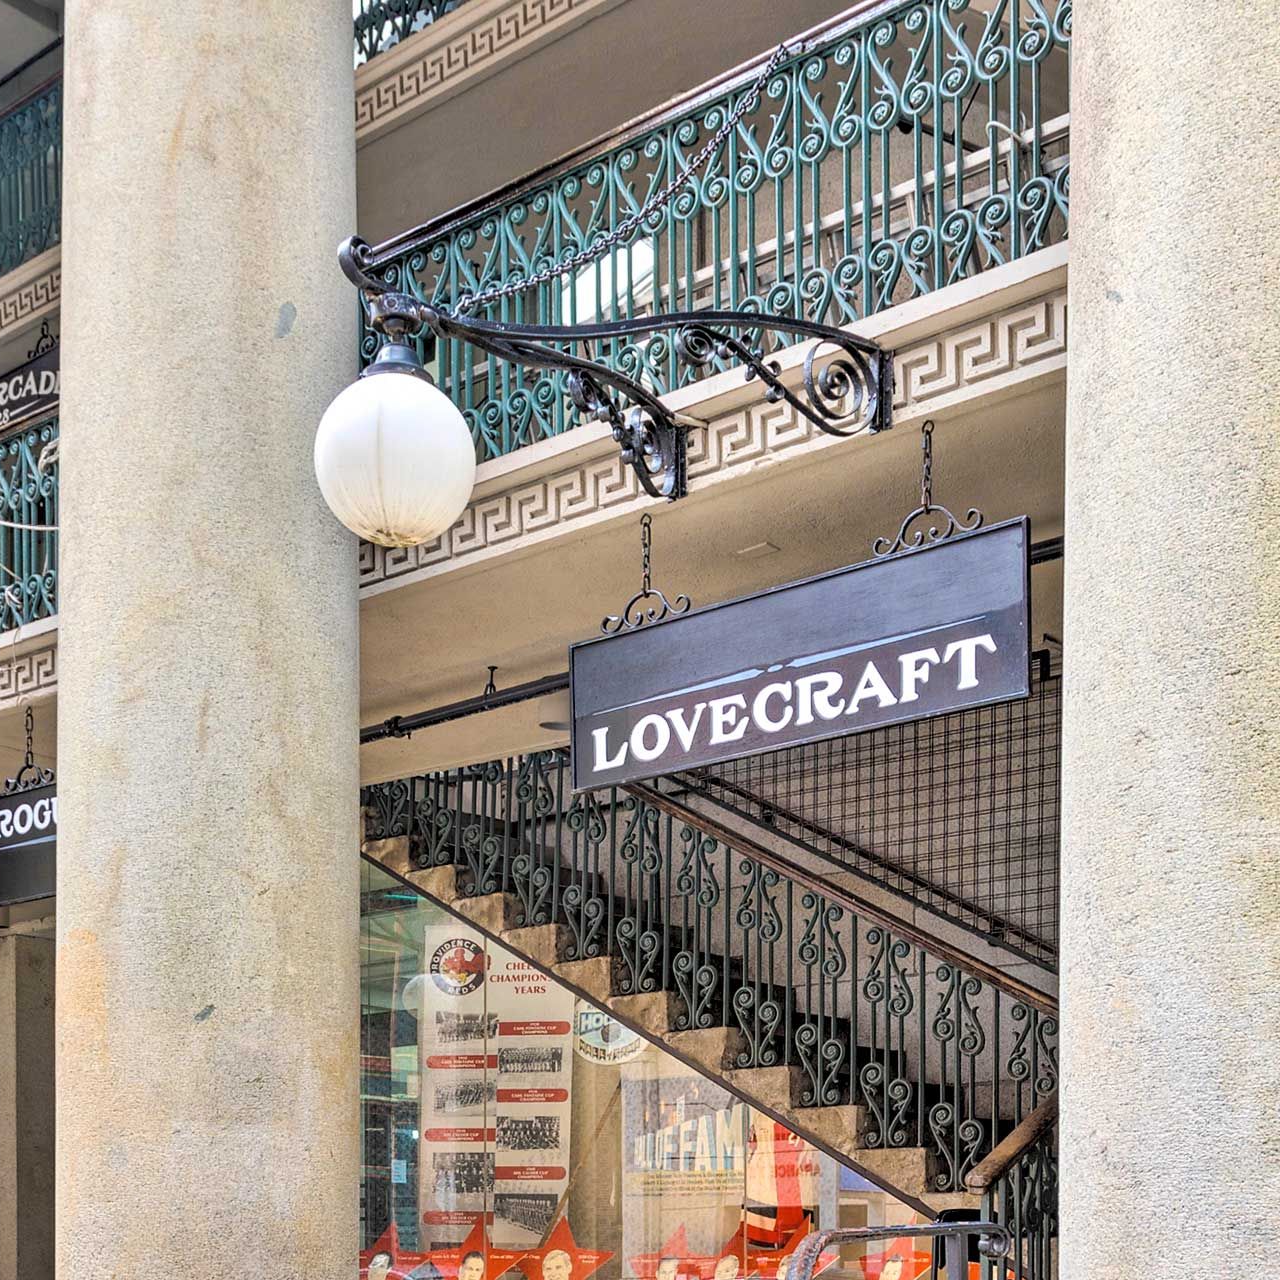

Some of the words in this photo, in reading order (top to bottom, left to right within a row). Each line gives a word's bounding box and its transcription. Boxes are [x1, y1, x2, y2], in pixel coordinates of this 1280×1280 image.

[592, 633, 998, 772] LOVECRAFT
[431, 939, 477, 976] PROVIDENCE
[447, 983, 476, 994] REDS
[514, 985, 547, 995] YEARS
